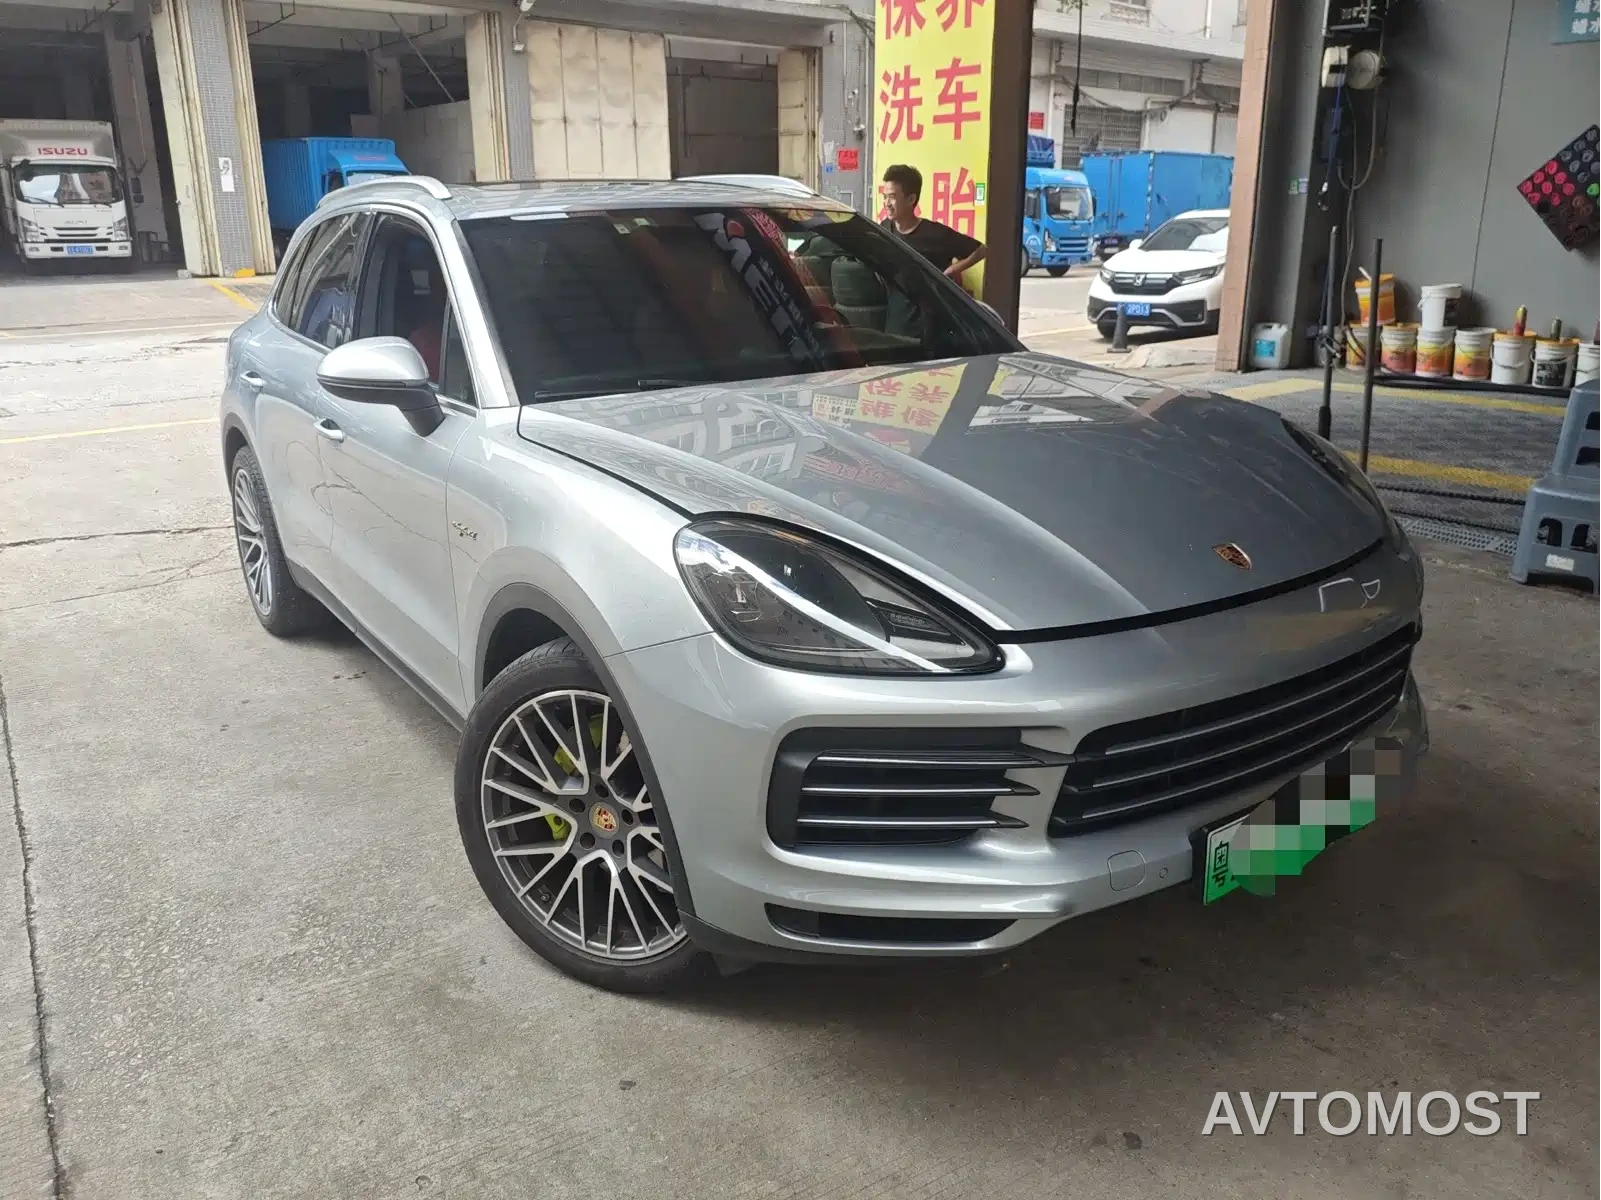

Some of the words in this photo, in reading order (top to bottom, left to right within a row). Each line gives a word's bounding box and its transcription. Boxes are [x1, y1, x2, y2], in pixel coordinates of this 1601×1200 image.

[879, 57, 982, 144] 洗车
[37, 147, 88, 156] ISUZU
[876, 167, 976, 240] 胎
